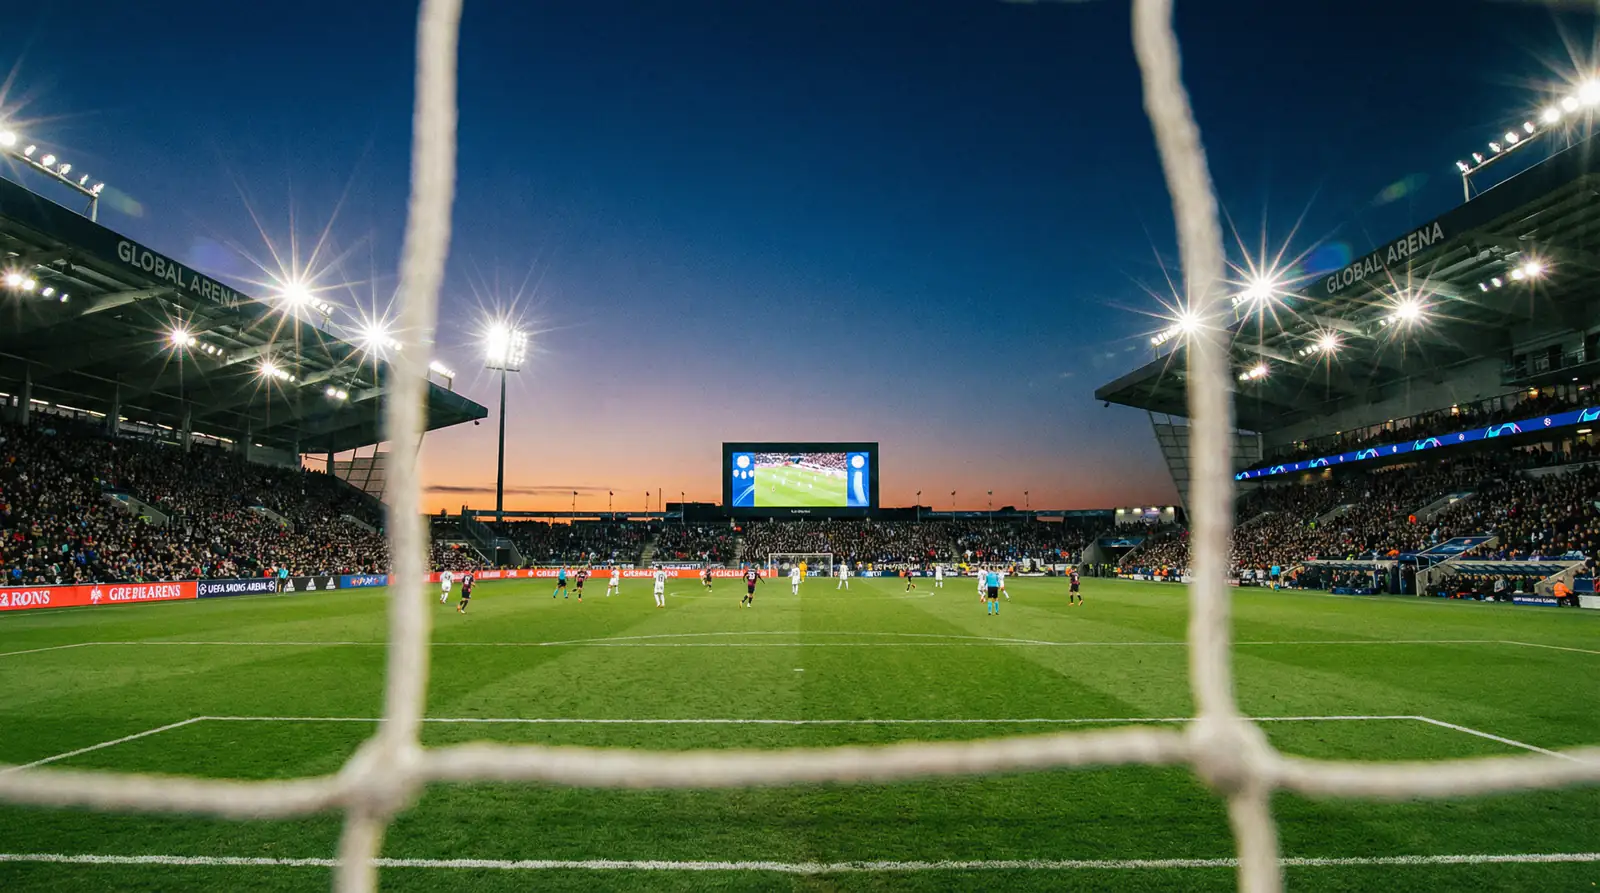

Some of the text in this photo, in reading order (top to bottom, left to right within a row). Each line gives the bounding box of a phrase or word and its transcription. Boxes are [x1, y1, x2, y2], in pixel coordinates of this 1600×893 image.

[118, 240, 240, 312] GLOBAL ARENA
[1326, 221, 1444, 294] GLOBAL ARENA
[11, 590, 51, 606] RONS
[208, 584, 225, 594] UEFA
